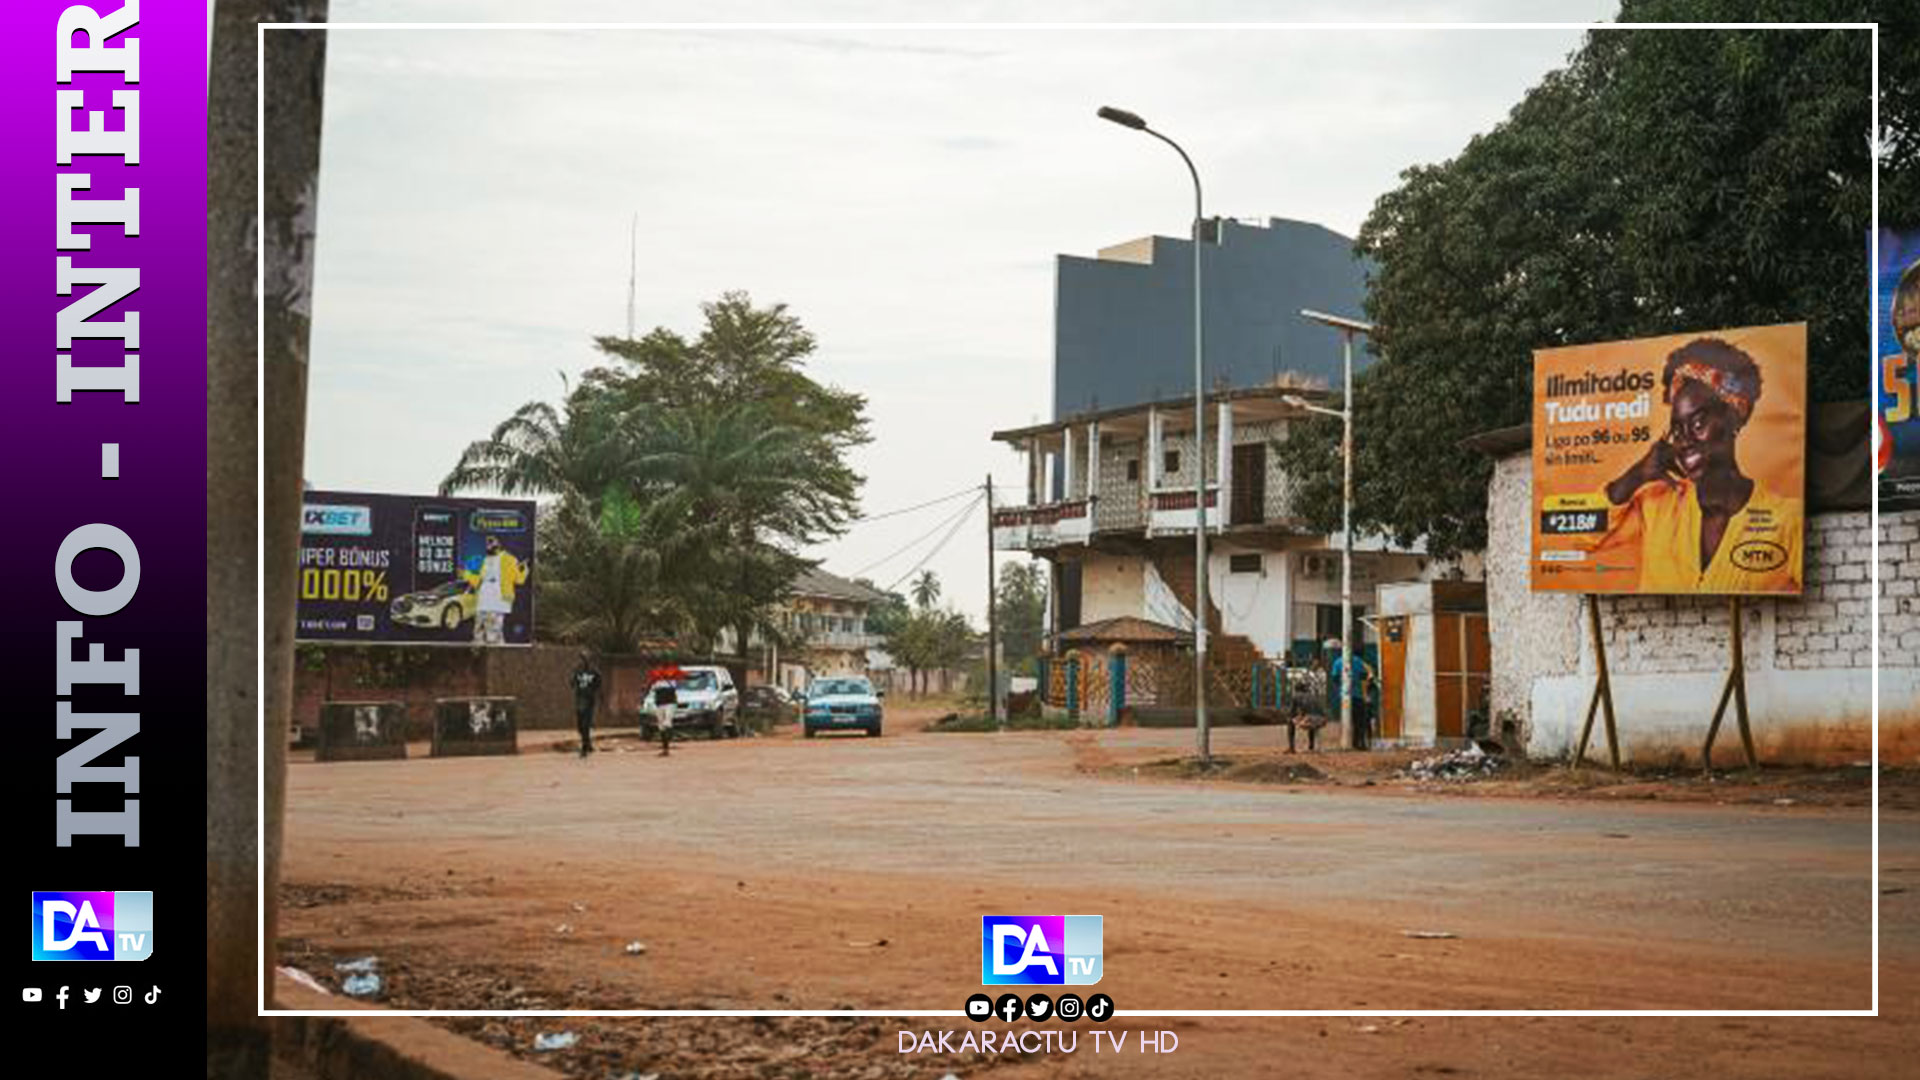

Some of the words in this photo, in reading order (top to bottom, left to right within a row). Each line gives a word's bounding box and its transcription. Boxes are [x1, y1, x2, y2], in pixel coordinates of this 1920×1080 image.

[1546, 369, 1655, 397] Ilimitados
[1545, 398, 1600, 424] Tudu
[1605, 392, 1651, 420] redi
[1592, 429, 1610, 445] 96
[1631, 425, 1651, 442] 95
[1741, 549, 1774, 563] MTN
